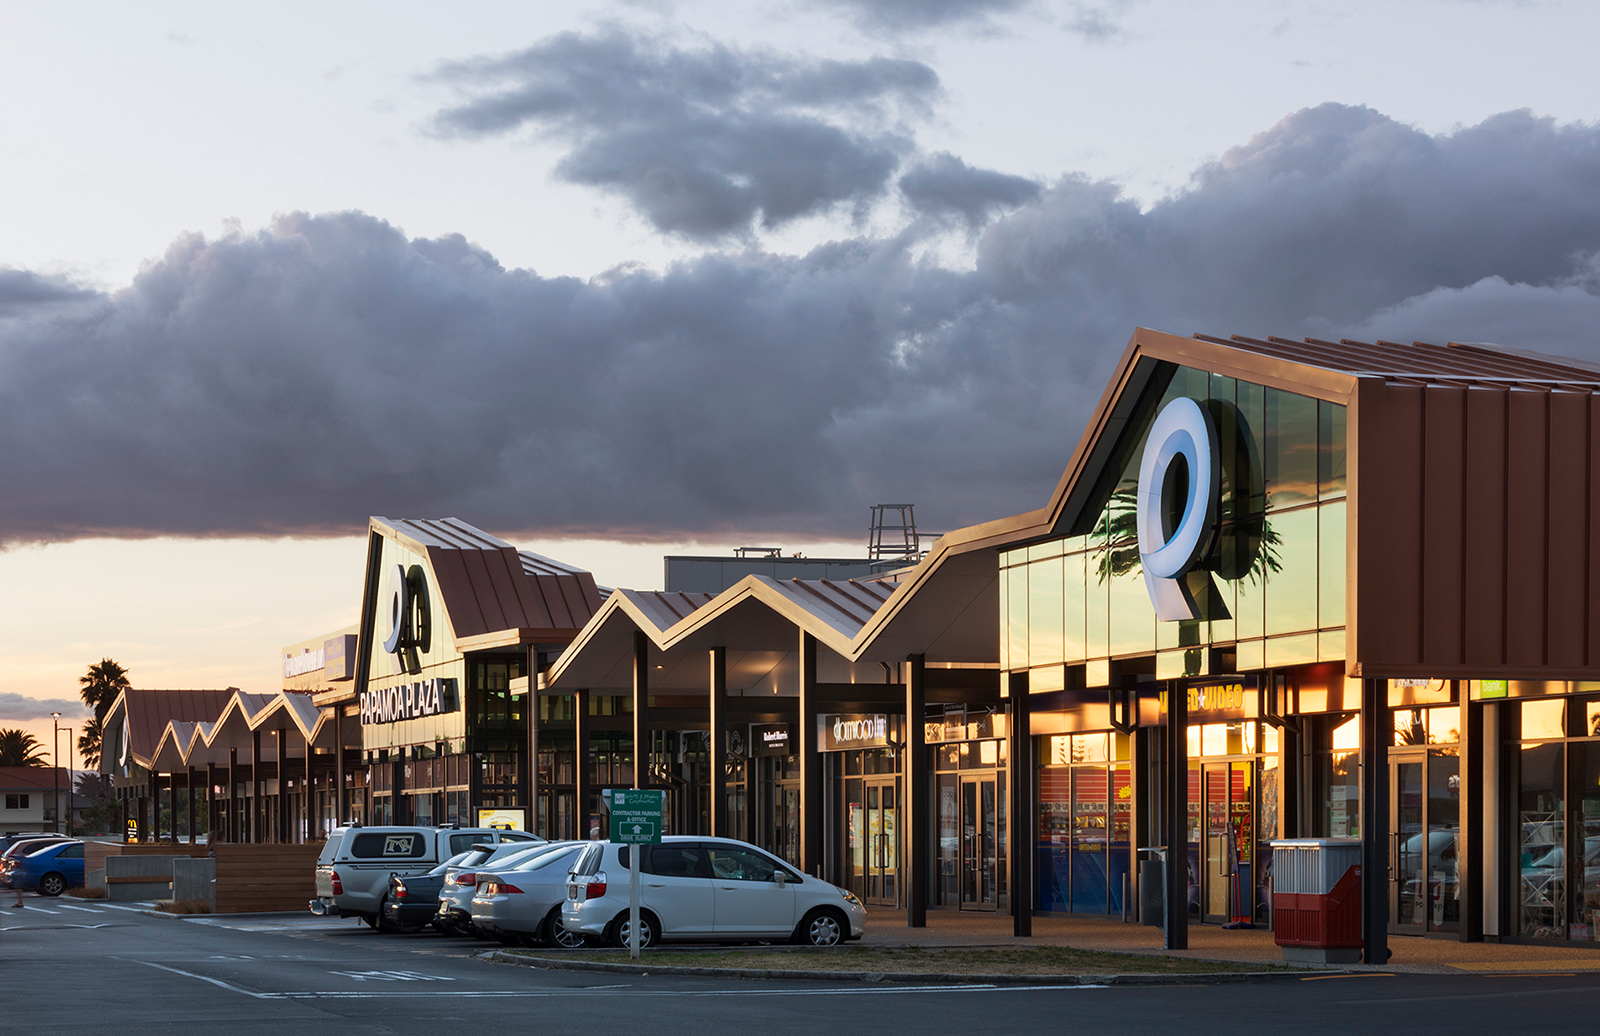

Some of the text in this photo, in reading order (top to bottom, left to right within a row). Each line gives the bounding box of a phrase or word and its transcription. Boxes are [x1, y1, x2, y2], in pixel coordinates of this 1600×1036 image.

[361, 677, 440, 725] PAPAMOA PLAZA
[1204, 684, 1243, 710] VIDEO
